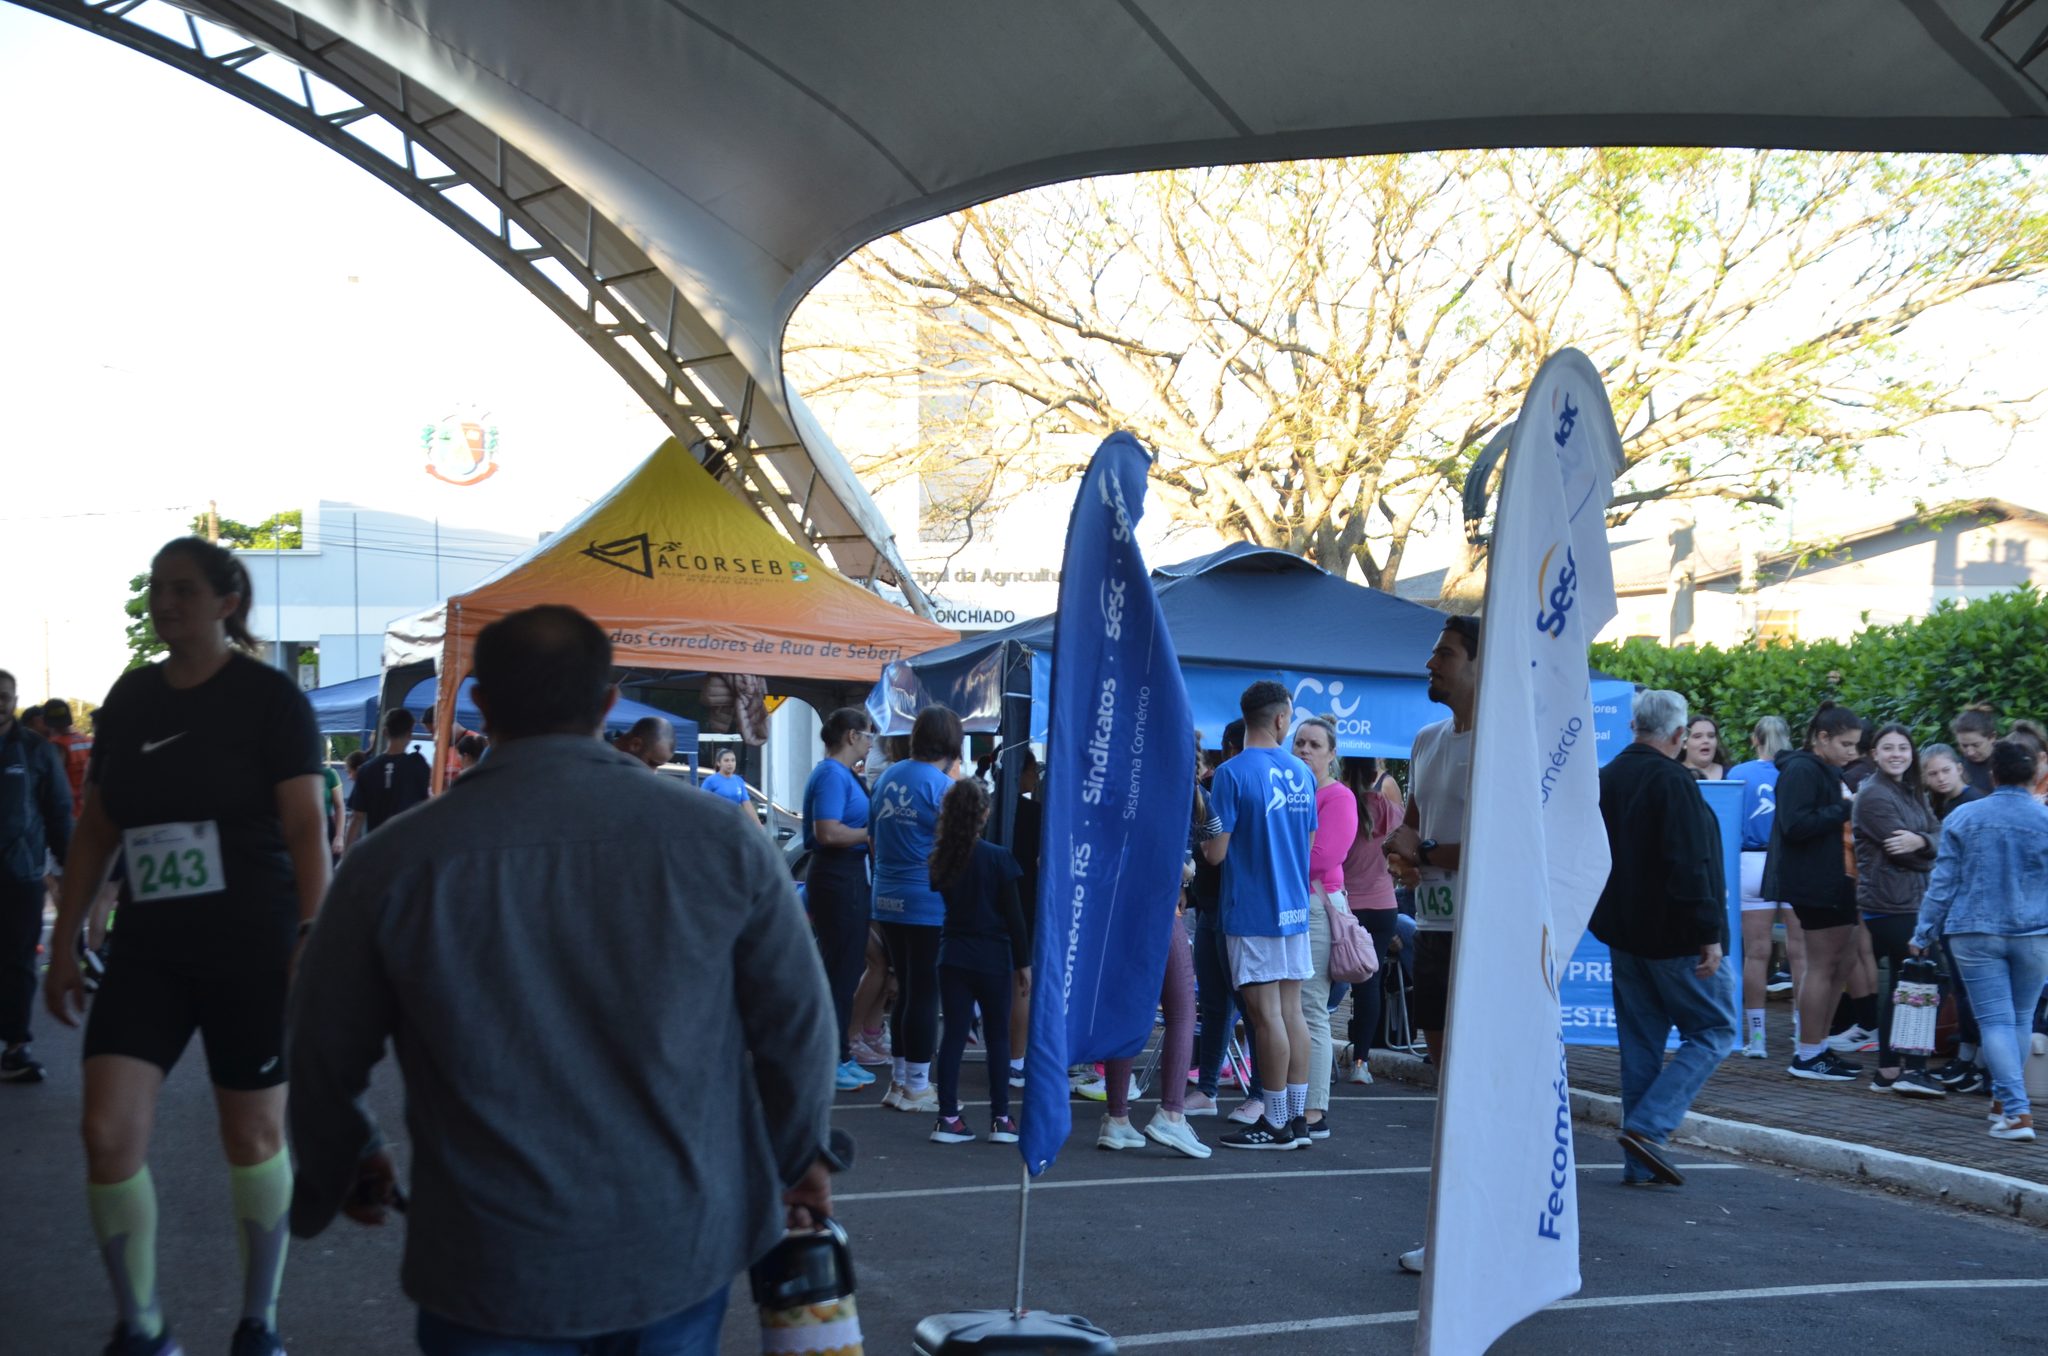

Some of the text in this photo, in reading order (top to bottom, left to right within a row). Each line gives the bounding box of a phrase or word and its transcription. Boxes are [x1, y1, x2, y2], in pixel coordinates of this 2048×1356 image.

[657, 553, 783, 576] ACORSEB
[954, 567, 976, 583] da
[936, 609, 1015, 624] ONCHIADO
[610, 628, 642, 645] dos
[648, 631, 747, 652] Corredores
[752, 639, 775, 654] de
[780, 639, 814, 656] Rua
[820, 641, 841, 658] de
[1593, 703, 1618, 714] ores
[1082, 678, 1117, 805] Sindicatos
[1123, 686, 1151, 820] Sistema Comércio
[137, 847, 209, 894] 243
[1074, 843, 1091, 878] RS
[1417, 886, 1454, 916] 143
